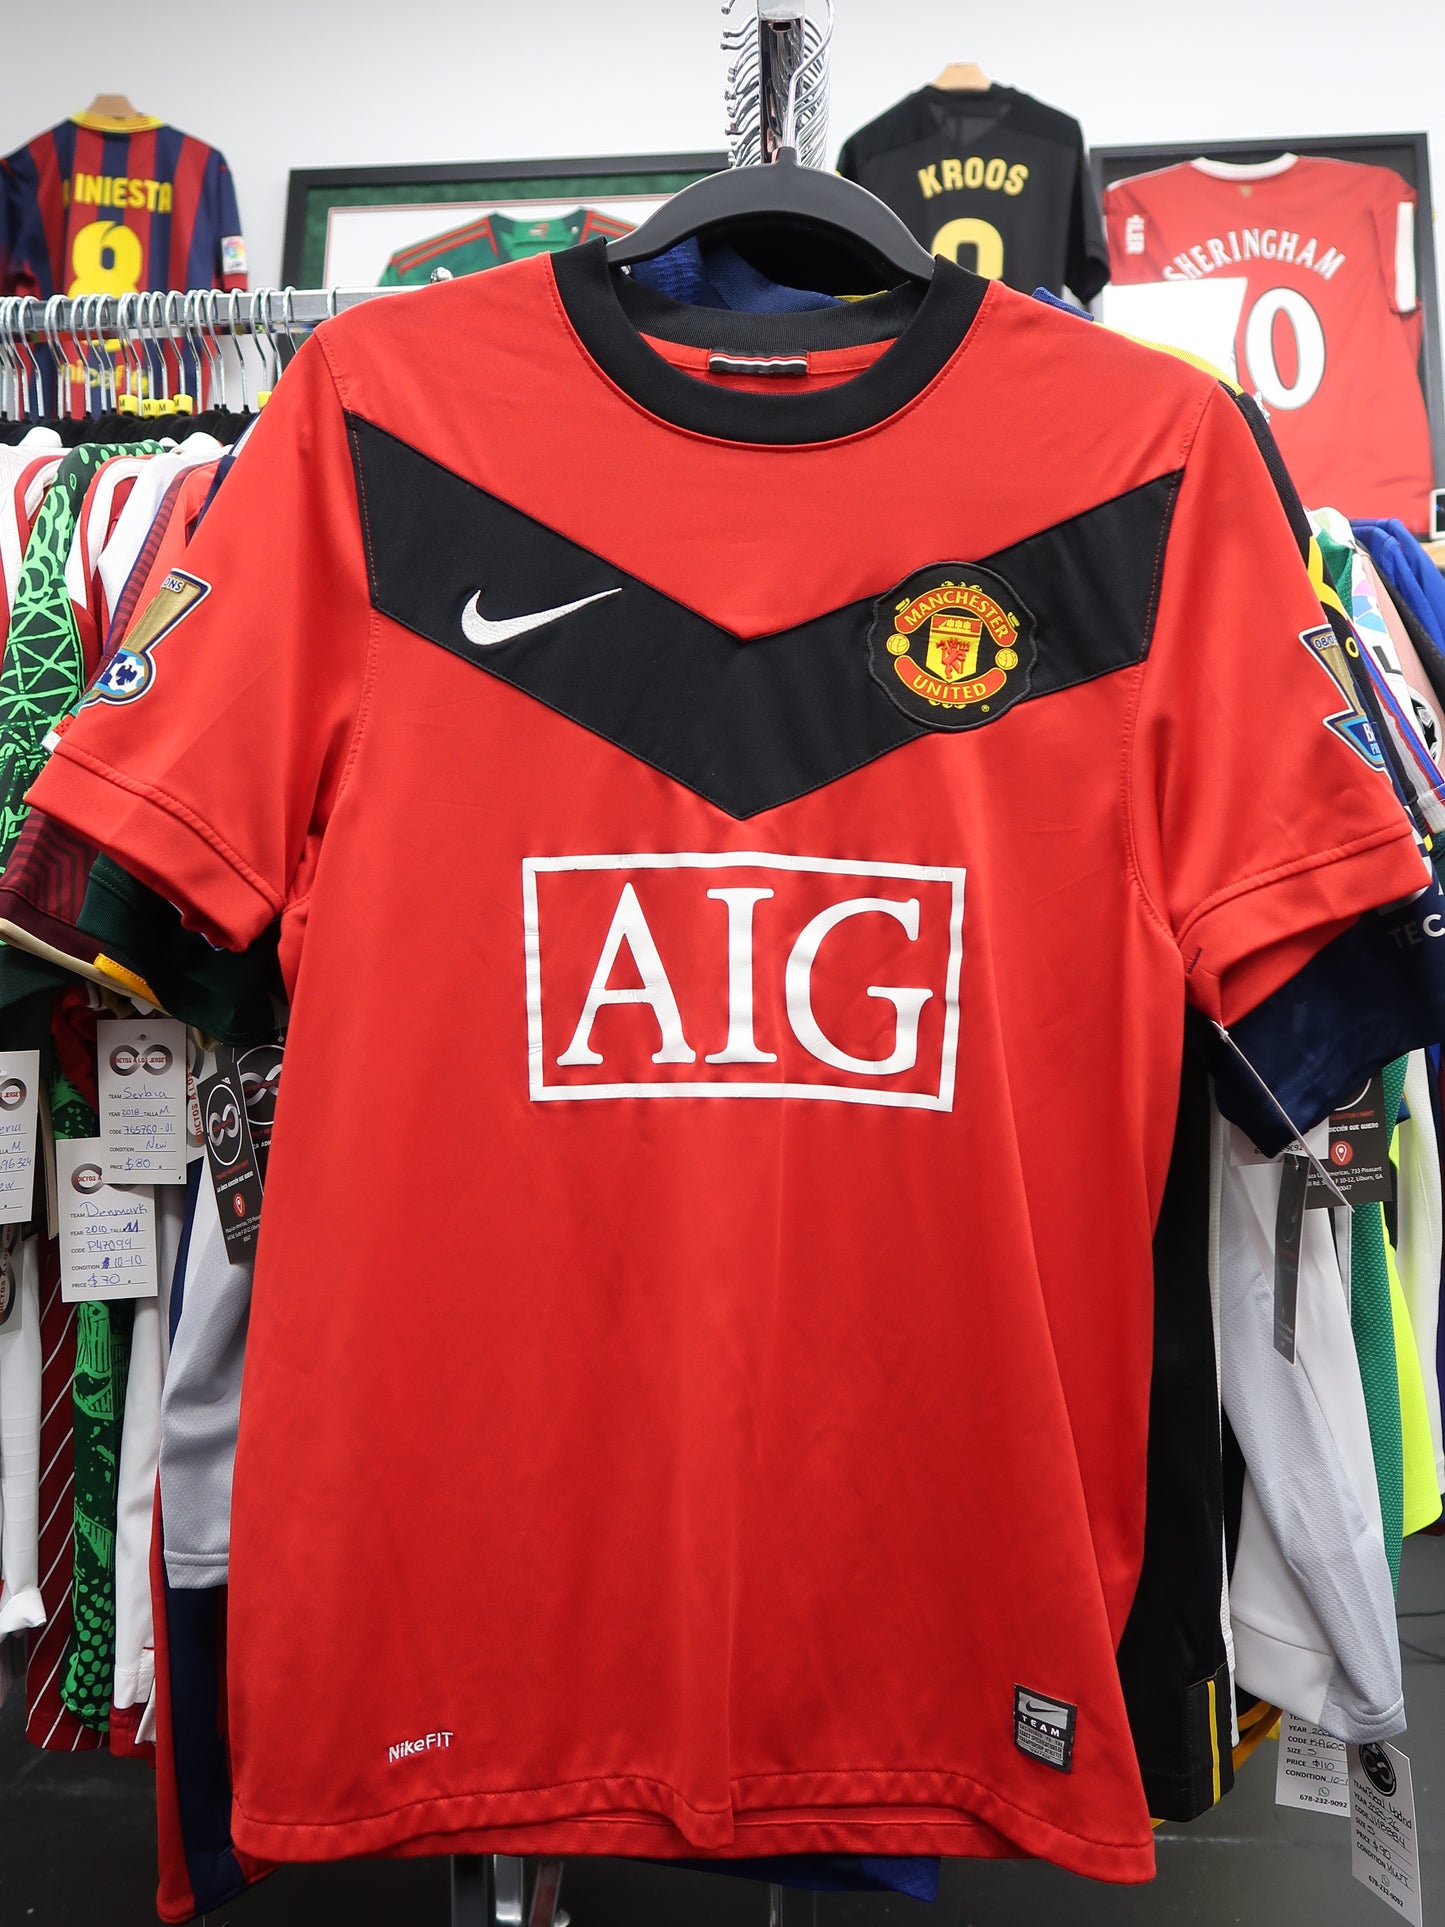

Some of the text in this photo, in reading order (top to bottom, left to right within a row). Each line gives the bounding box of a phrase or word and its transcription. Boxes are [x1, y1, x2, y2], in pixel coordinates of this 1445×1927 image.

[917, 156, 1029, 199] KROOS
[74, 173, 173, 214] INIESTA
[1162, 227, 1346, 282] SHERINGHAM
[1232, 285, 1328, 411] 0
[904, 591, 1009, 639] MANCHESTER
[913, 675, 987, 700] UNITED
[556, 881, 933, 1075] AIG
[123, 1084, 167, 1099] Serbia
[146, 1136, 167, 1150] New
[126, 1157, 151, 1170] $80
[85, 1224, 107, 1234] 2010
[1022, 1715, 1061, 1738] TEAM
[1289, 1724, 1307, 1733] YEAR
[388, 1731, 454, 1763] NikeFIT
[1288, 1736, 1307, 1744] CODE
[1286, 1758, 1335, 1771] PRICE $110
[1285, 1769, 1327, 1782] CONDITION
[1299, 1794, 1348, 1808] 678-232-9092
